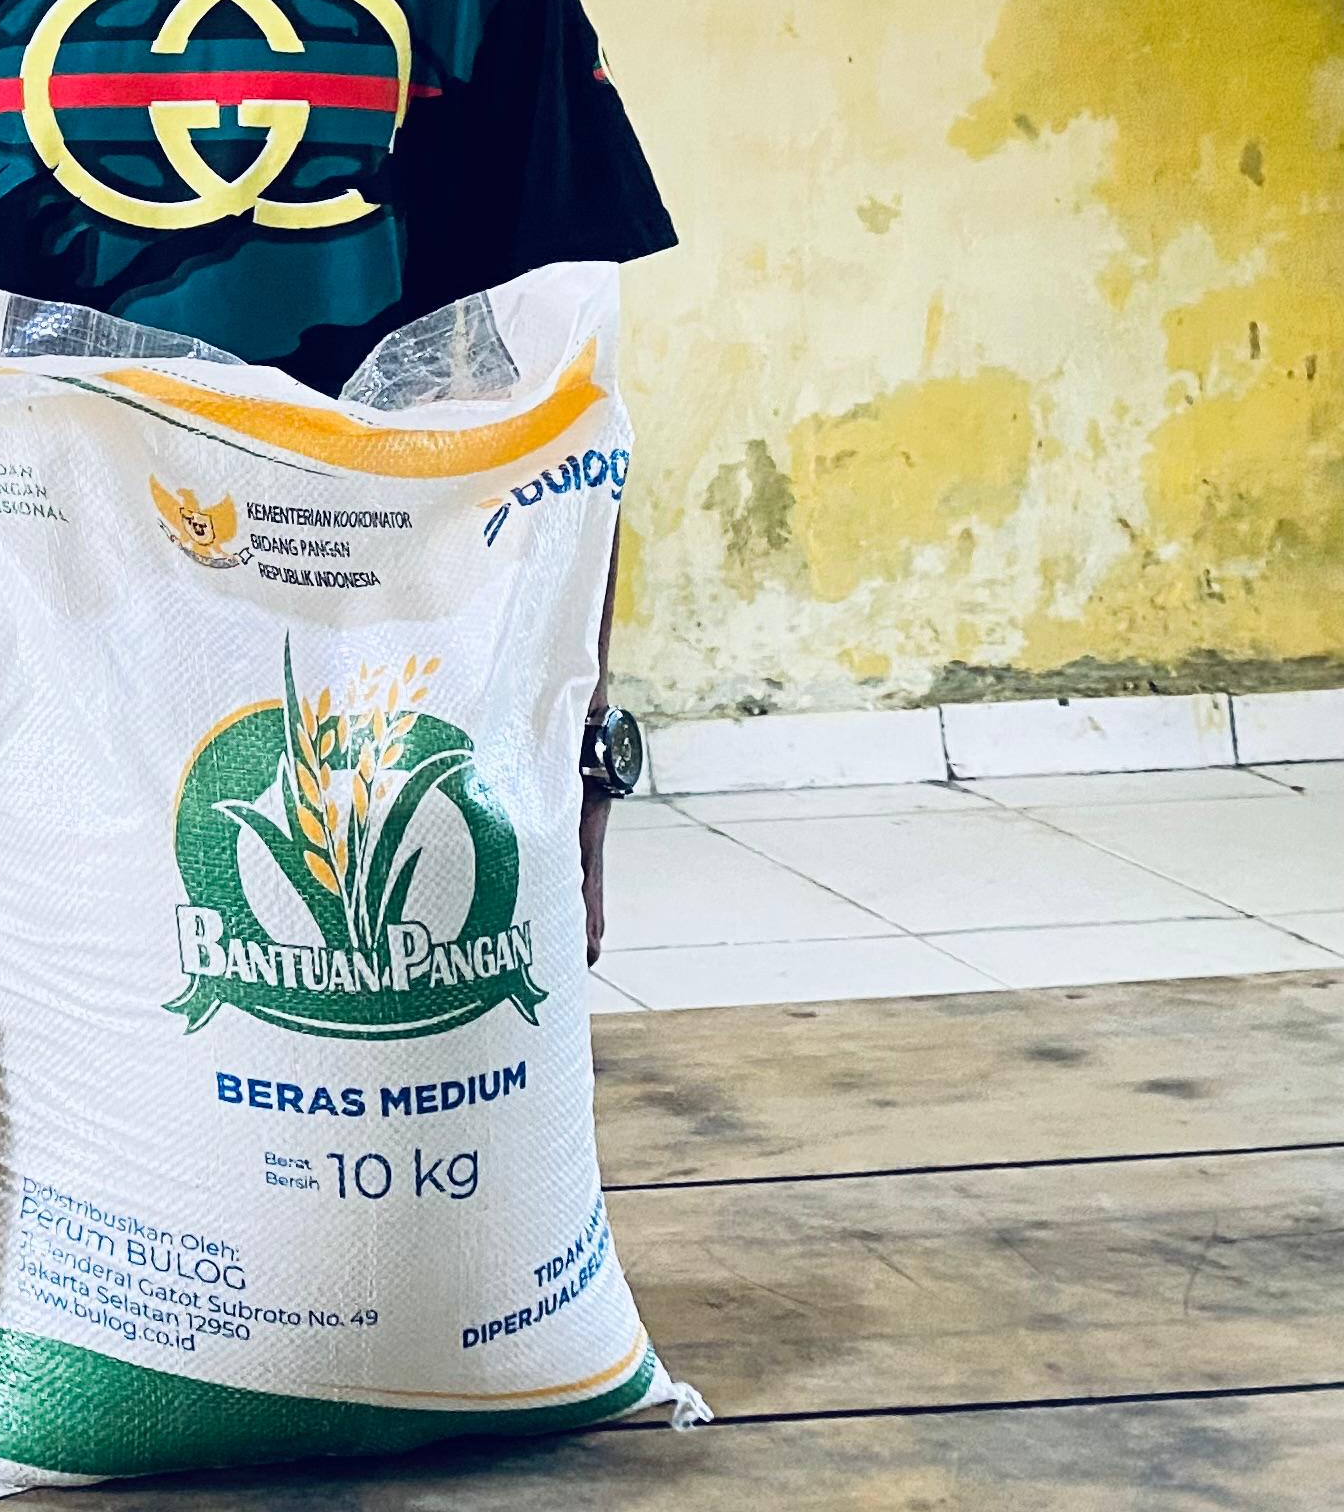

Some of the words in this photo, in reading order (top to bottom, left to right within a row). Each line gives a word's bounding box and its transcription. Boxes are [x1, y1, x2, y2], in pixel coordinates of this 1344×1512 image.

[509, 447, 631, 507] bulog
[246, 502, 332, 528] KEMENTERIAN
[333, 503, 412, 529] KOORDINATOR
[250, 533, 298, 556] BIDANG
[300, 540, 350, 558] PANGAN
[258, 562, 312, 588] REPUBLIK
[313, 567, 381, 589] INDONESIA
[175, 904, 384, 993] BANTUAN
[387, 920, 533, 991] PANGAN
[216, 1071, 366, 1117] BERAS
[380, 1061, 527, 1117] MEDIUM
[264, 1152, 313, 1170] Berat
[265, 1171, 320, 1192] Bersih
[326, 1152, 393, 1200] 10
[415, 1148, 479, 1200] kg
[20, 1196, 115, 1257] Perum
[126, 1239, 247, 1291] BULOG
[23, 1176, 173, 1246] Didistribusikan
[181, 1233, 241, 1262] Oleh:
[534, 1233, 584, 1287] TIDAK
[16, 1255, 89, 1297] Jakarta
[97, 1287, 179, 1327] Selatan
[186, 1312, 250, 1341] 12950
[139, 1280, 201, 1311] Gatot
[208, 1291, 301, 1326] Subroto
[308, 1310, 344, 1327] No.
[350, 1310, 378, 1327] 49
